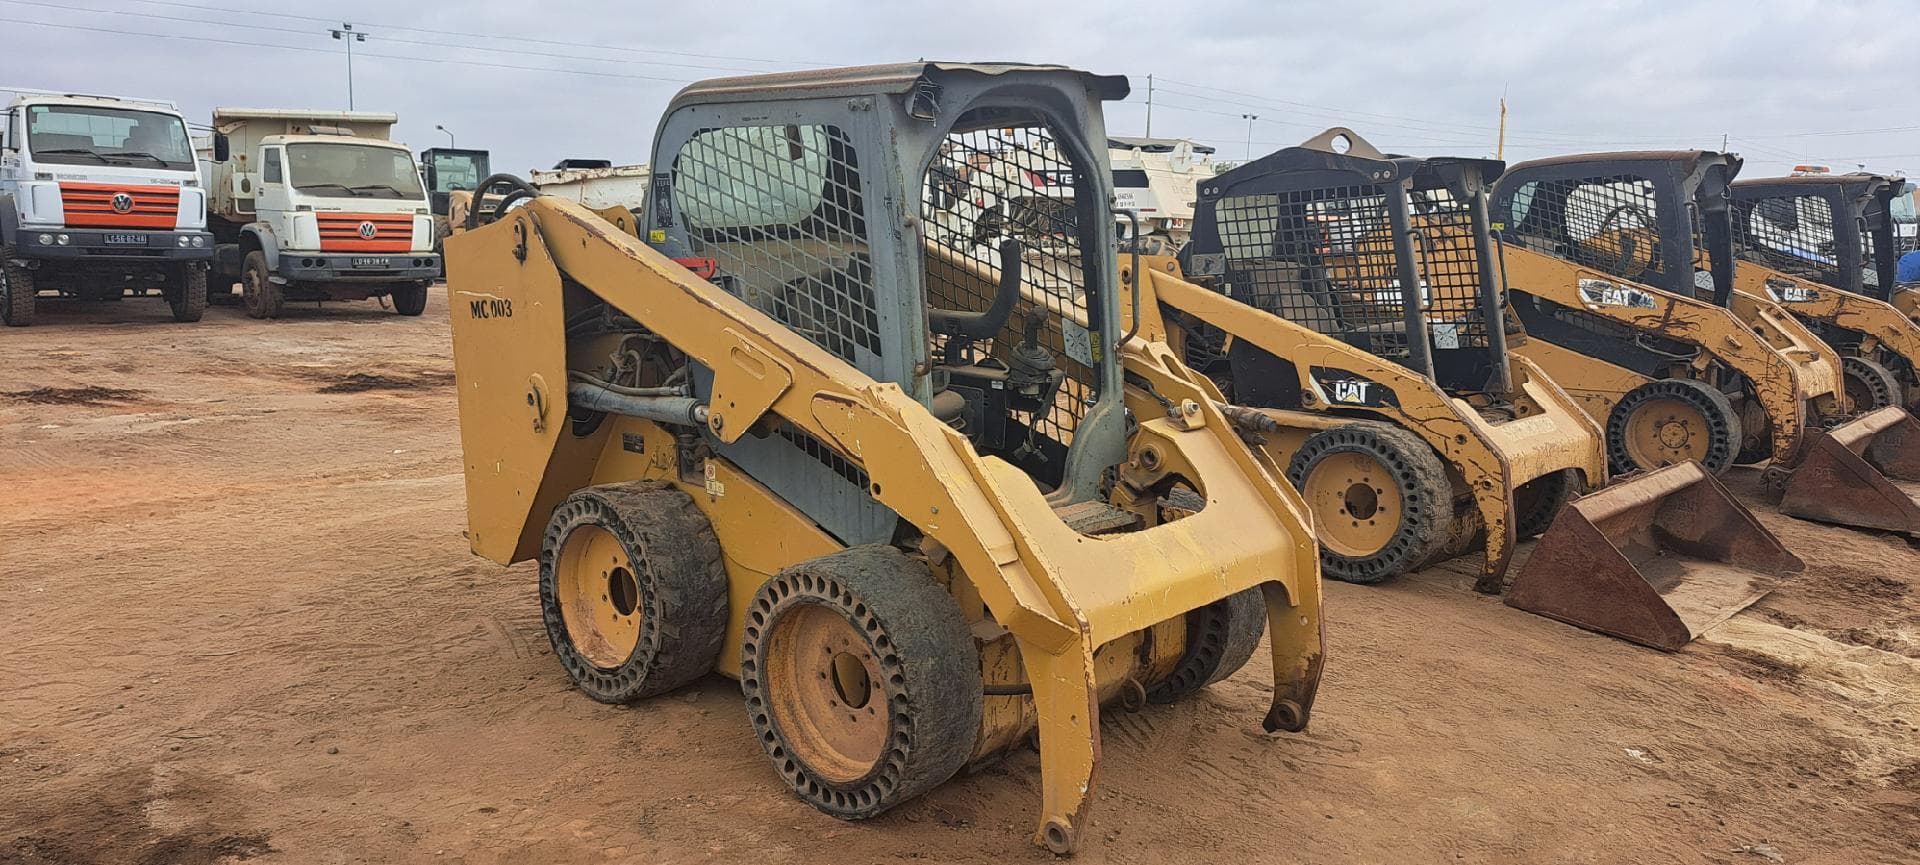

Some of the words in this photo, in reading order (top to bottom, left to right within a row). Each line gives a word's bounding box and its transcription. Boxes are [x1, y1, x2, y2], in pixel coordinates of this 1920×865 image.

[1602, 286, 1630, 306] CAT
[1784, 287, 1808, 301] CAT
[470, 300, 489, 319] MC
[490, 299, 512, 318] 003
[1335, 380, 1369, 403] CAT
